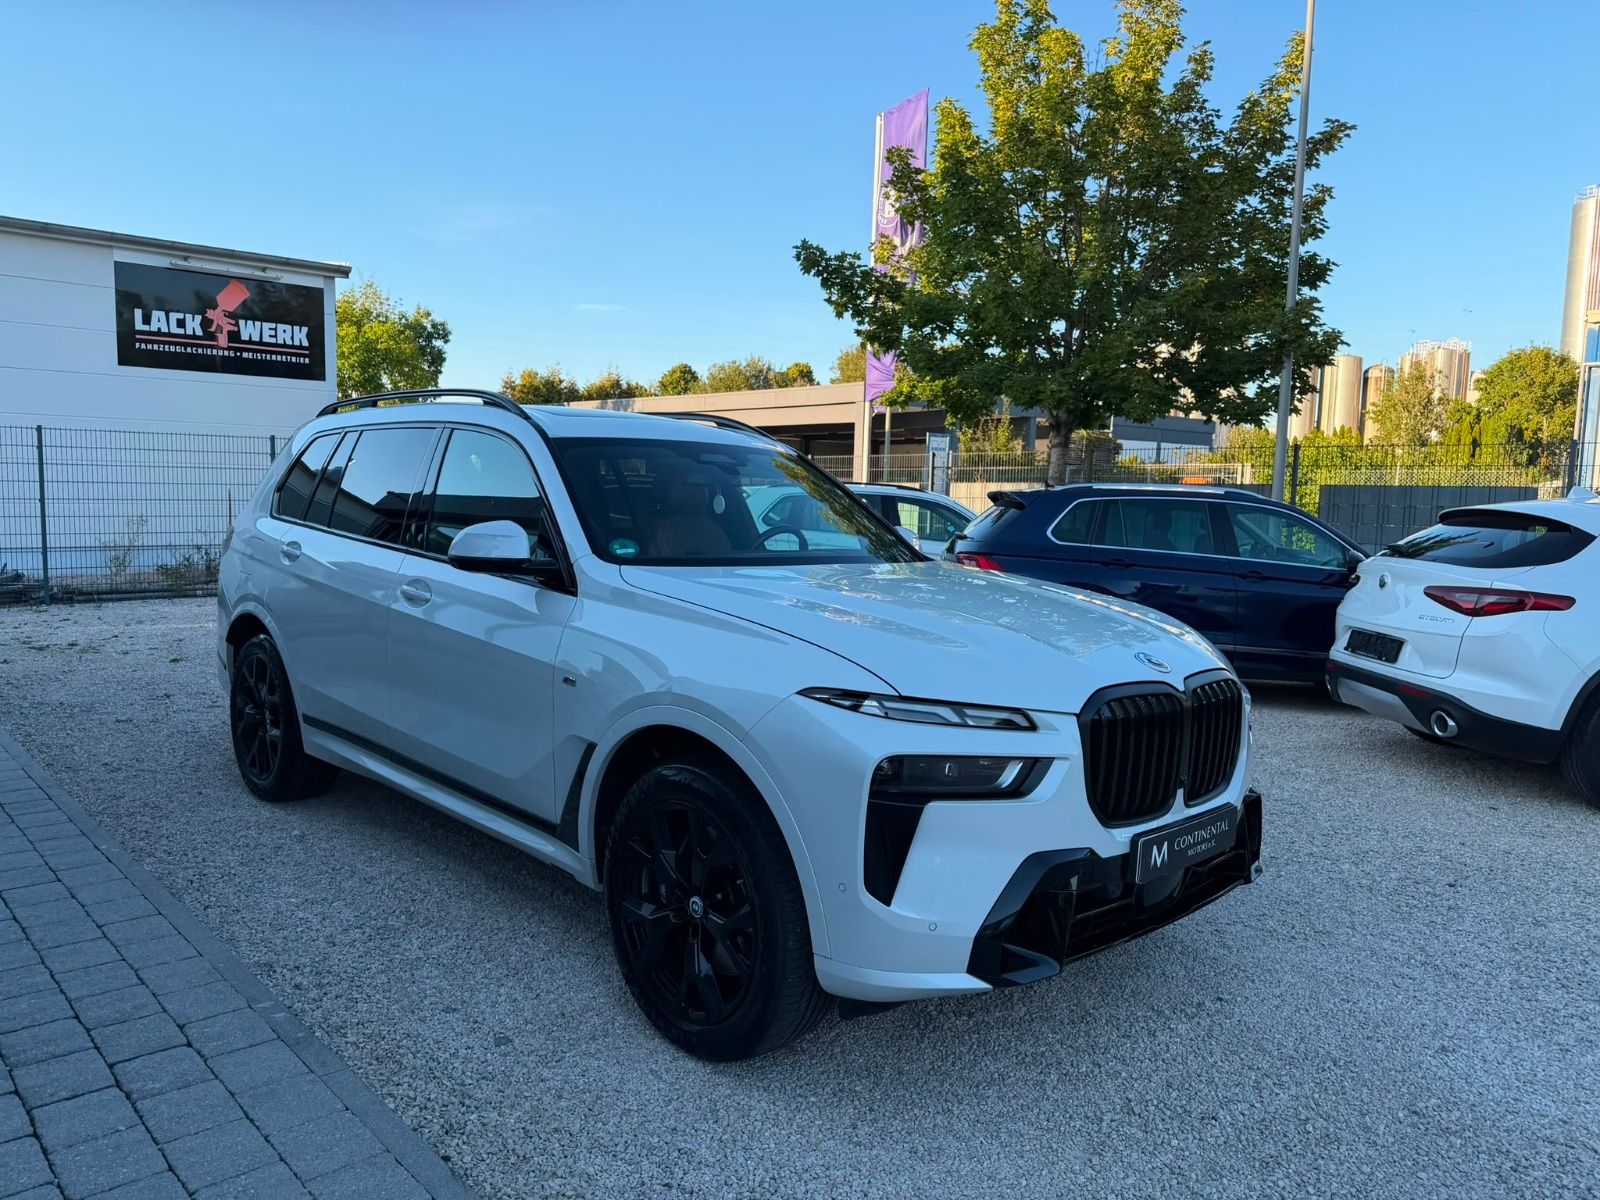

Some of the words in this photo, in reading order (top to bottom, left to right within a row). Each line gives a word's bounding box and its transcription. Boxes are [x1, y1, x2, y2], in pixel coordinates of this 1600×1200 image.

[134, 308, 204, 337] LACK
[238, 319, 310, 347] WERK
[135, 342, 235, 357] FAHRZEUGLACKIERUNG
[242, 351, 310, 364] MEISTERBETRIEB
[1174, 818, 1229, 850] CONTINENTAL
[1150, 841, 1168, 871] M
